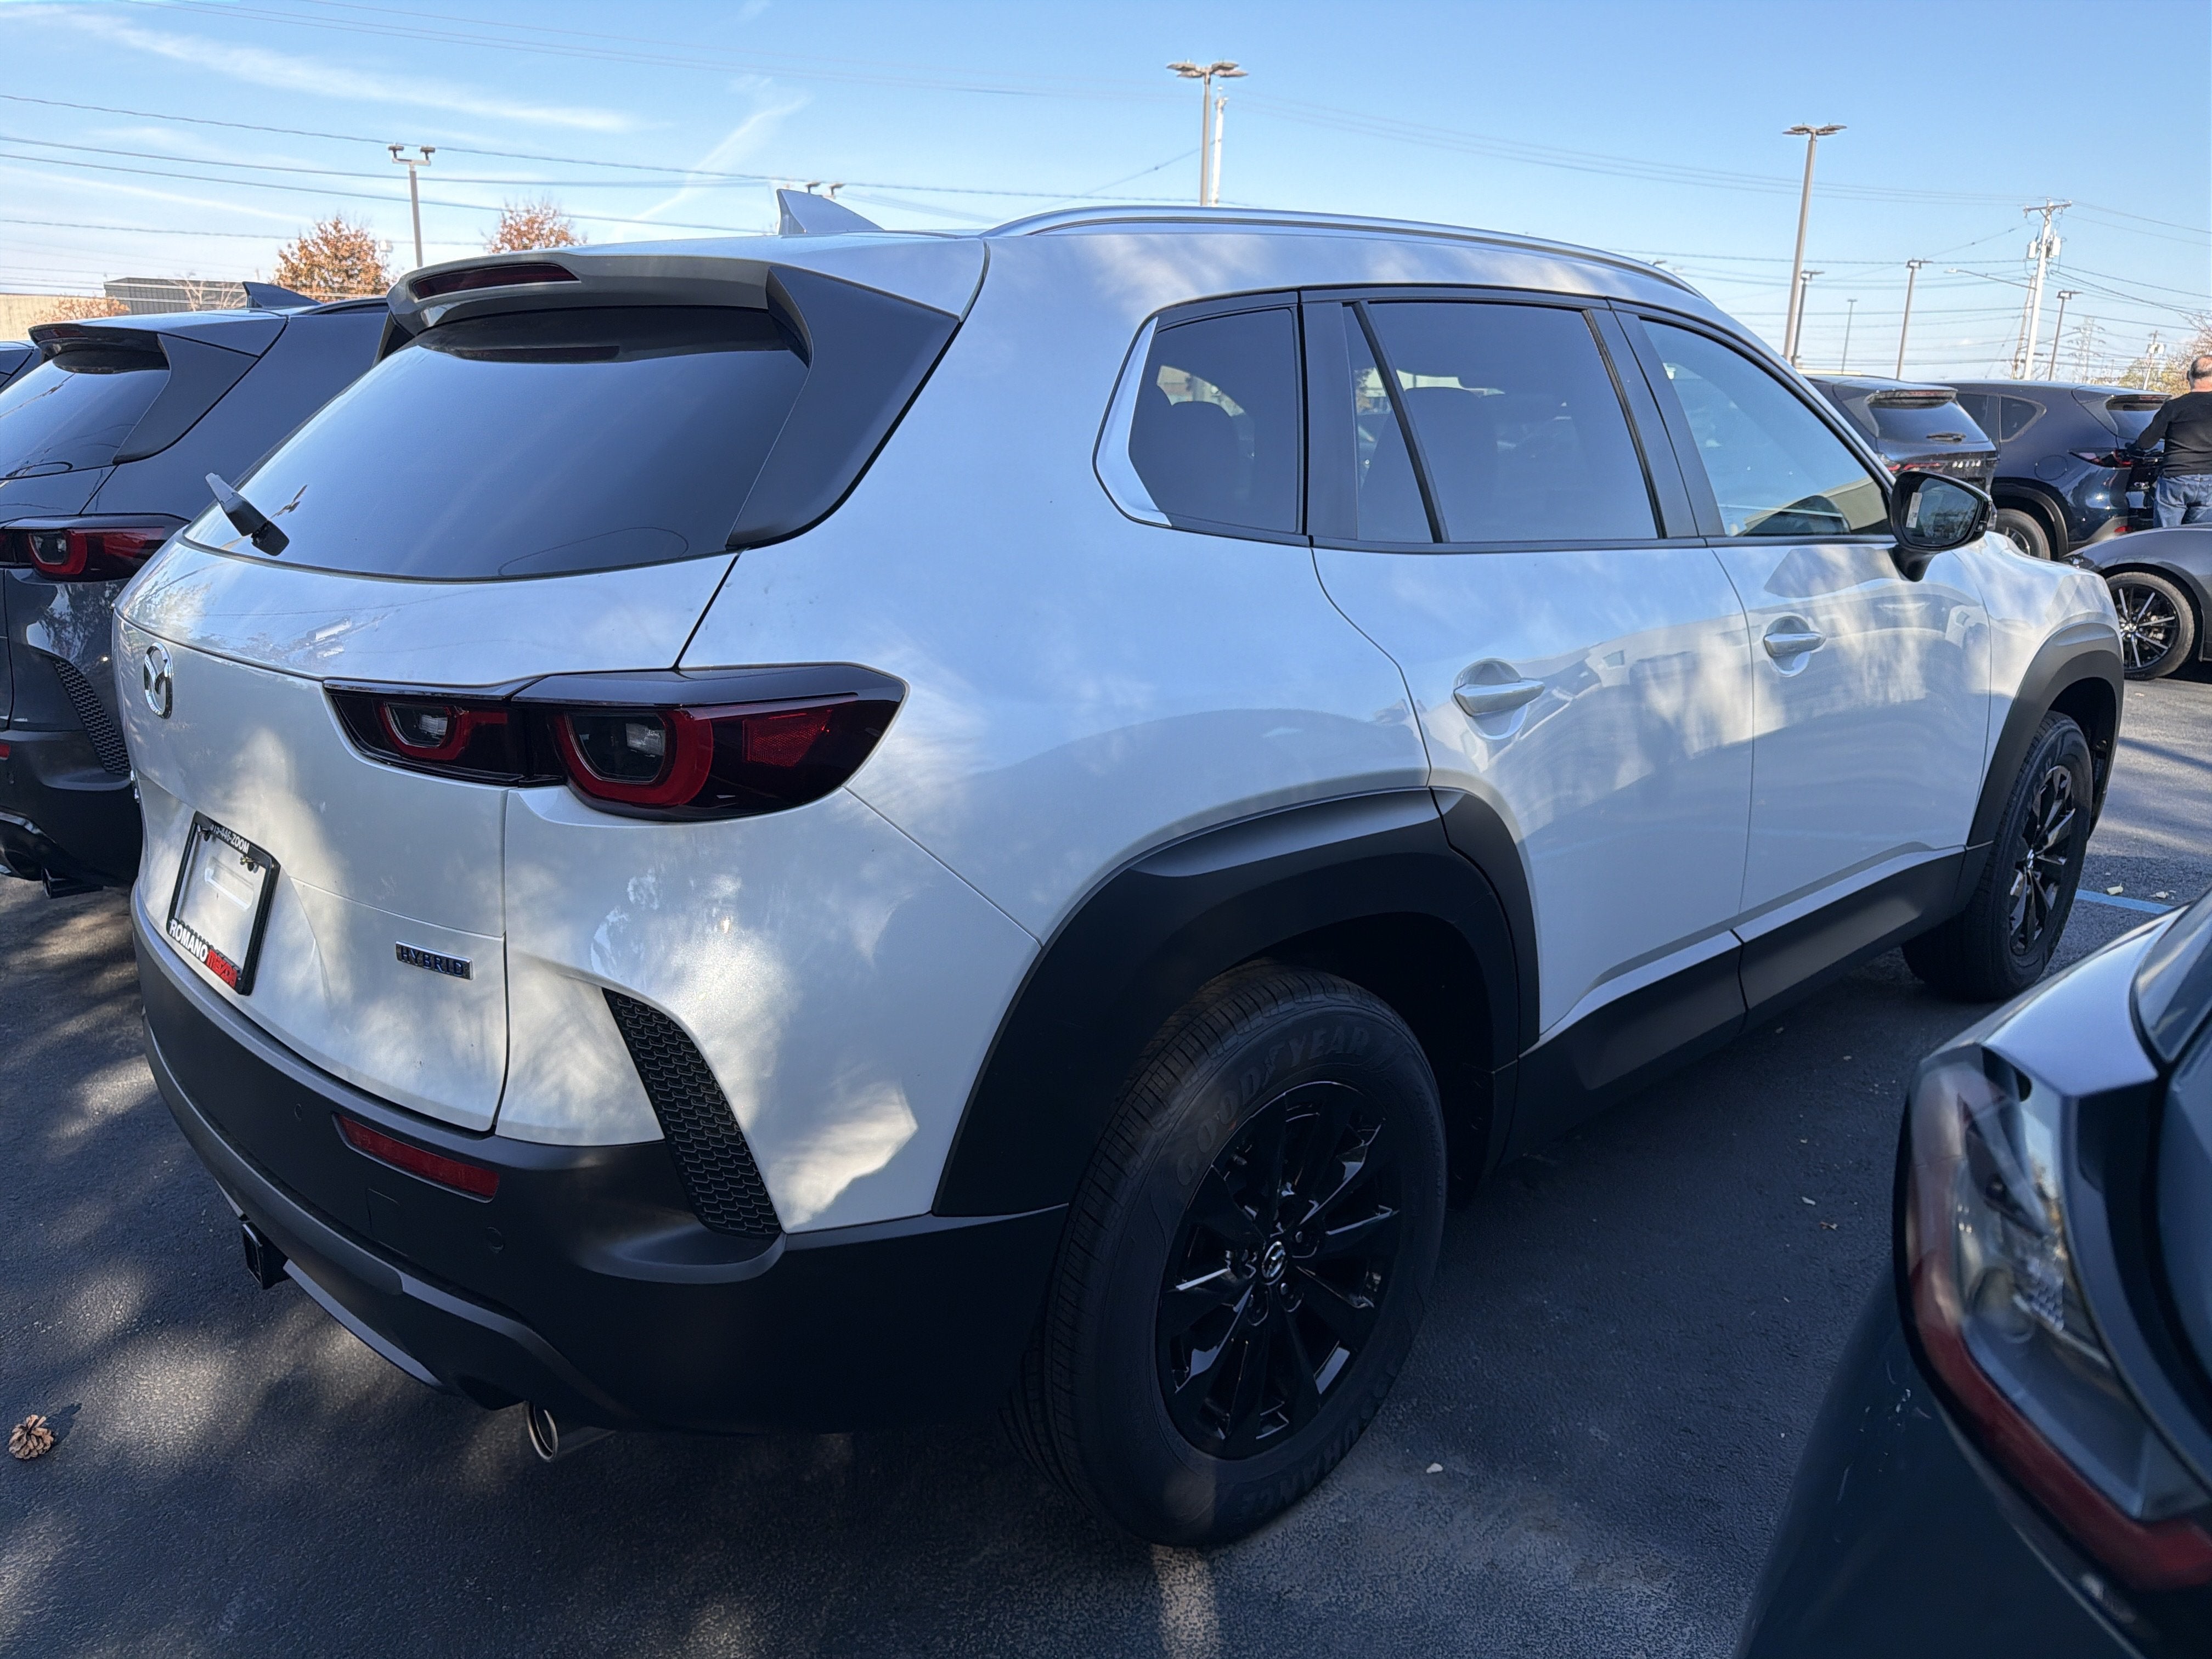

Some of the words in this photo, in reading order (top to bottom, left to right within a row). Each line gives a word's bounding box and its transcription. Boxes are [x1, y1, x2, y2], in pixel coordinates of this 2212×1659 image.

[169, 918, 208, 962] ROMANO
[400, 946, 464, 977] HYBRID
[1176, 1024, 1371, 1186] GOODYEAR
